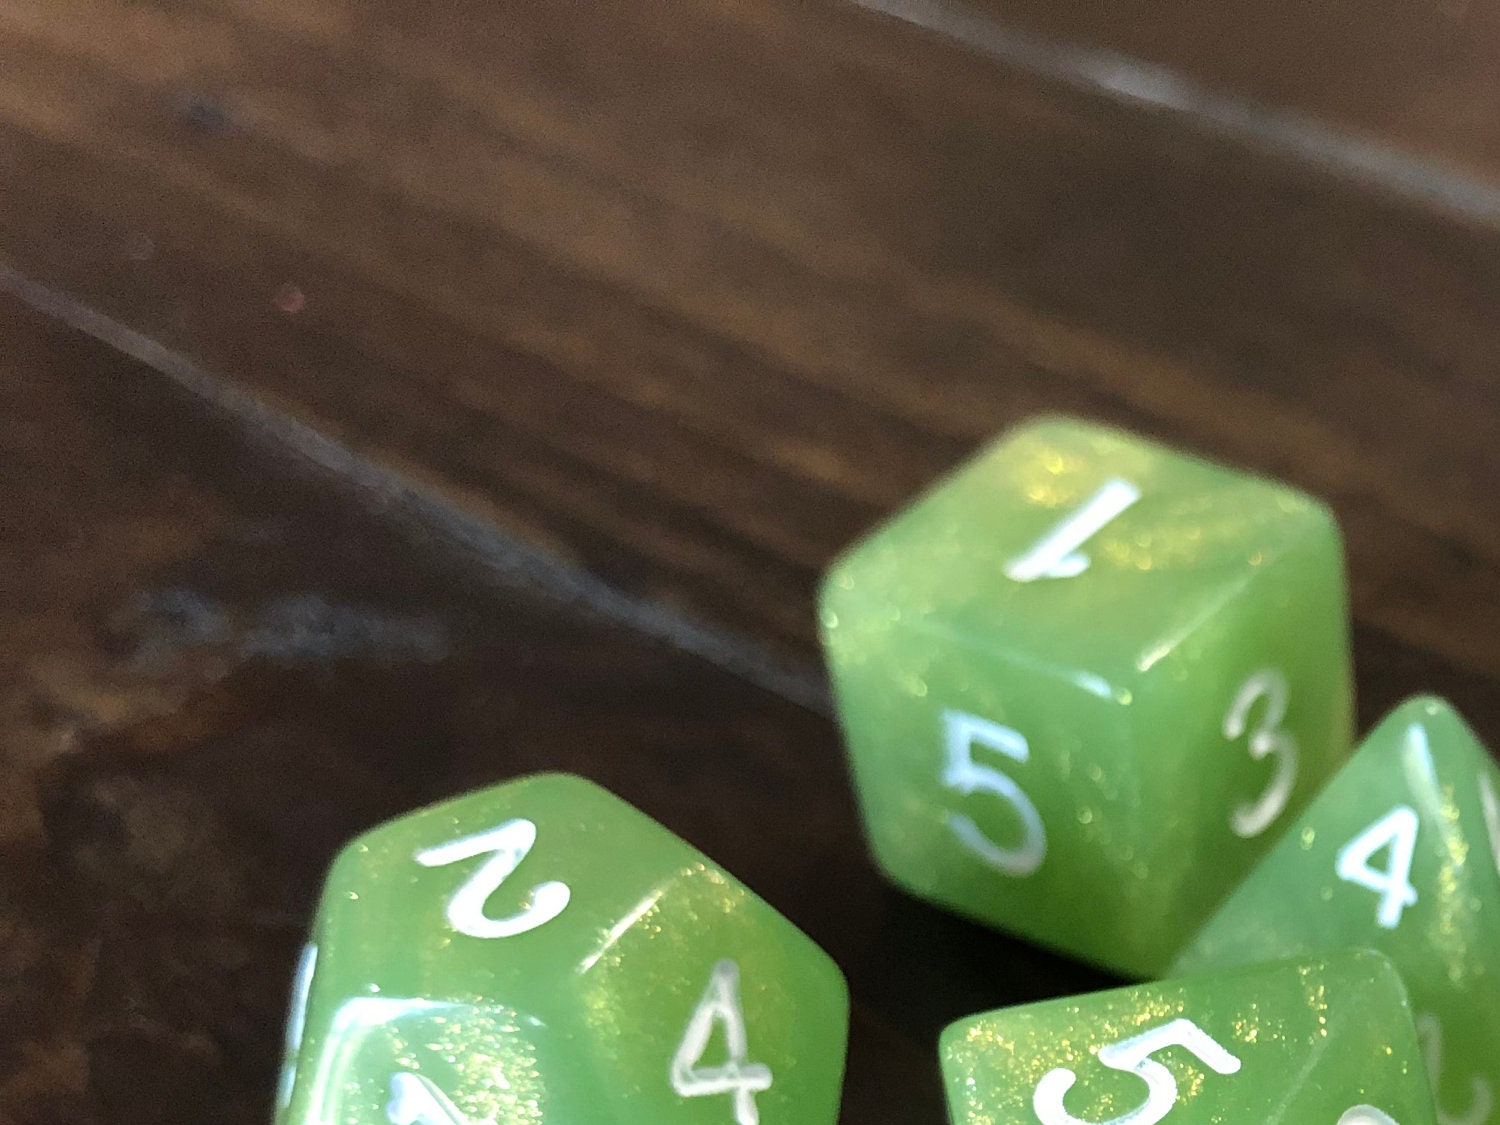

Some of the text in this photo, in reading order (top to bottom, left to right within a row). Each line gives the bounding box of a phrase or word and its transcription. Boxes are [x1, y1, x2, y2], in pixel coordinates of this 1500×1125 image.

[1005, 478, 1140, 582] 1
[941, 708, 1046, 878] 5
[1223, 669, 1298, 839] 3
[416, 819, 571, 938] 2
[1336, 805, 1418, 929] 4
